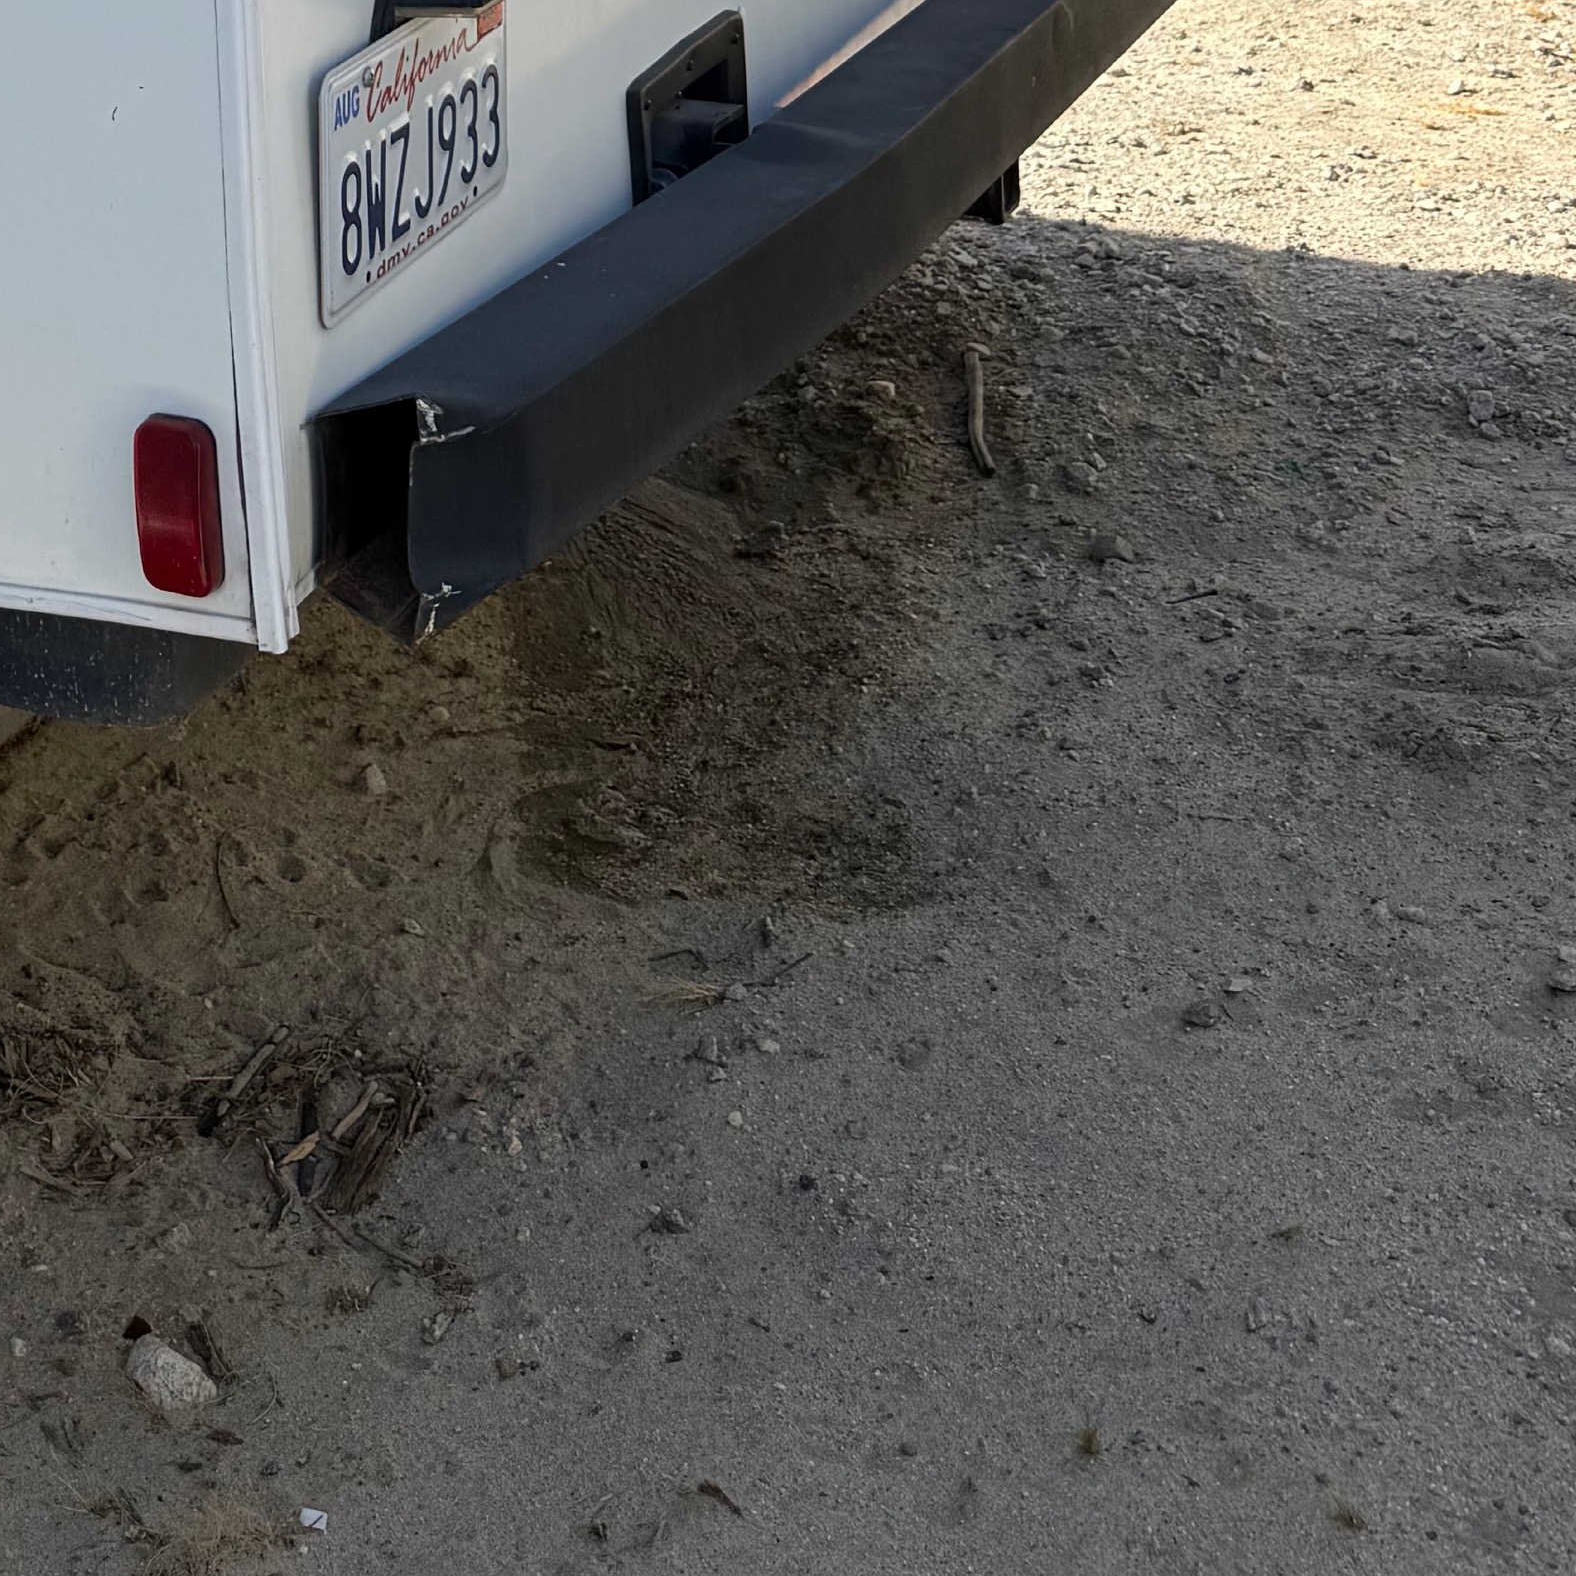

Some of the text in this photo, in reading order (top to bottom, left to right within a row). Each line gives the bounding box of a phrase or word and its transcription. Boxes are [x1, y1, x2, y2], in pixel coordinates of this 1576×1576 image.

[334, 85, 361, 131] AUG
[366, 18, 477, 123] California
[341, 64, 500, 276] 8WZJ933
[376, 195, 469, 281] dmv.ca.gov
